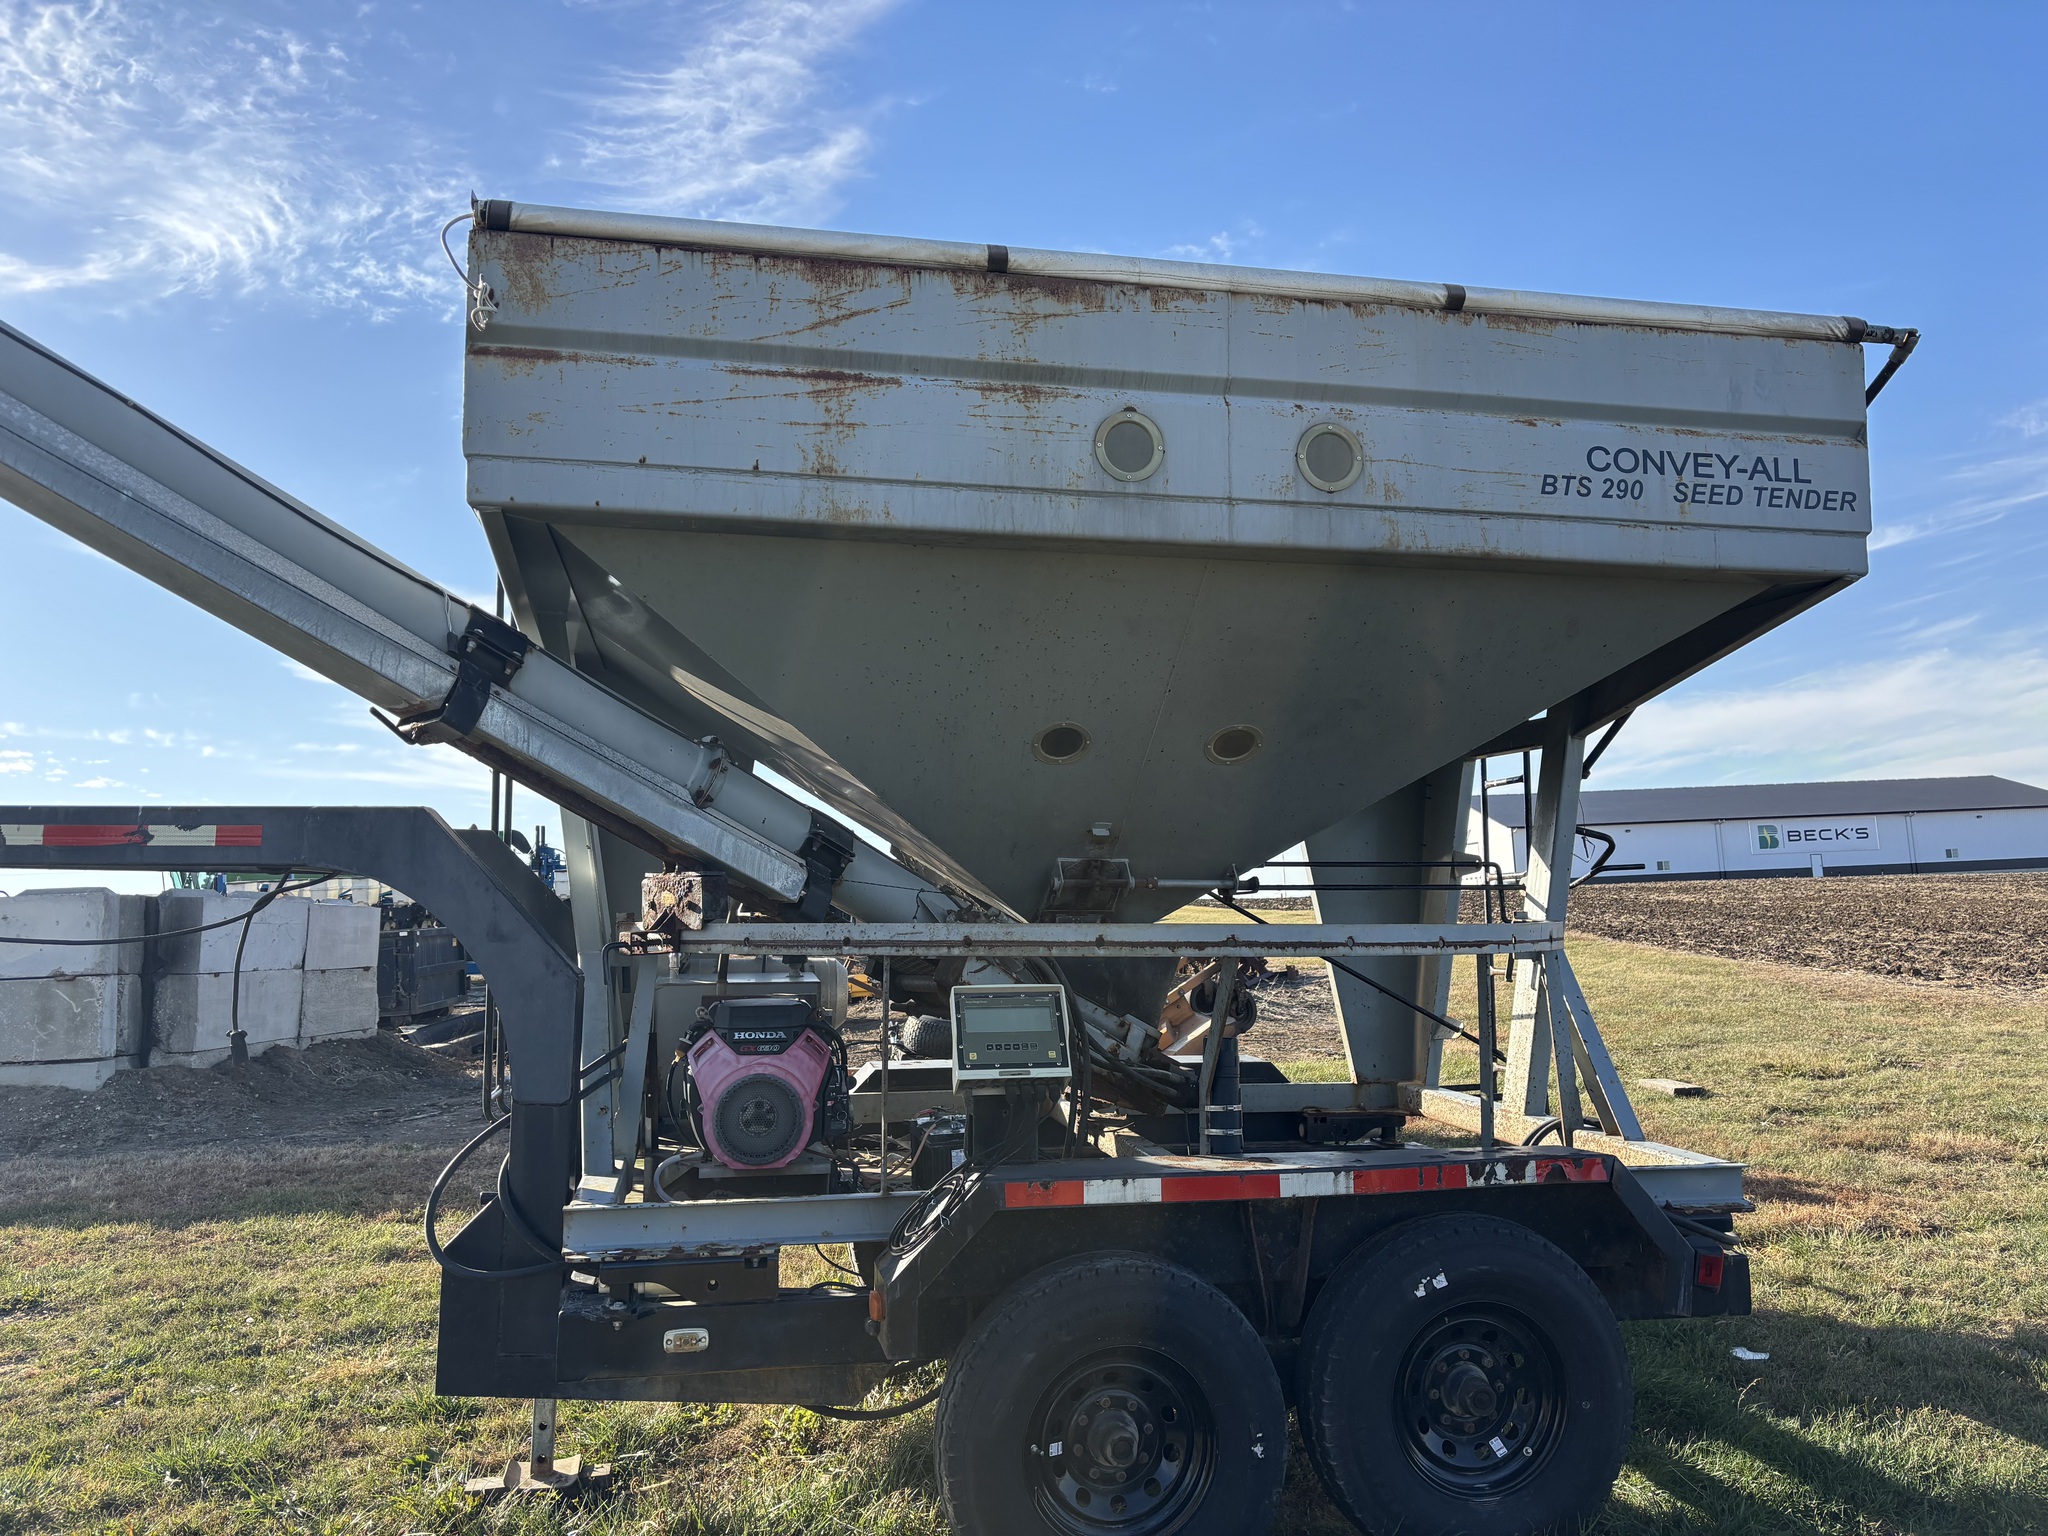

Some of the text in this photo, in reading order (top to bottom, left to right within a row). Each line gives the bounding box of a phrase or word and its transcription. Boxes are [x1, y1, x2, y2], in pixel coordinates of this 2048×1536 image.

[1586, 445, 1812, 484] CONVEY-ALL
[1540, 474, 1857, 512] BTS 290 SEED TENDER
[1787, 827, 1869, 842] BECK'S
[733, 1031, 787, 1040] HONDA
